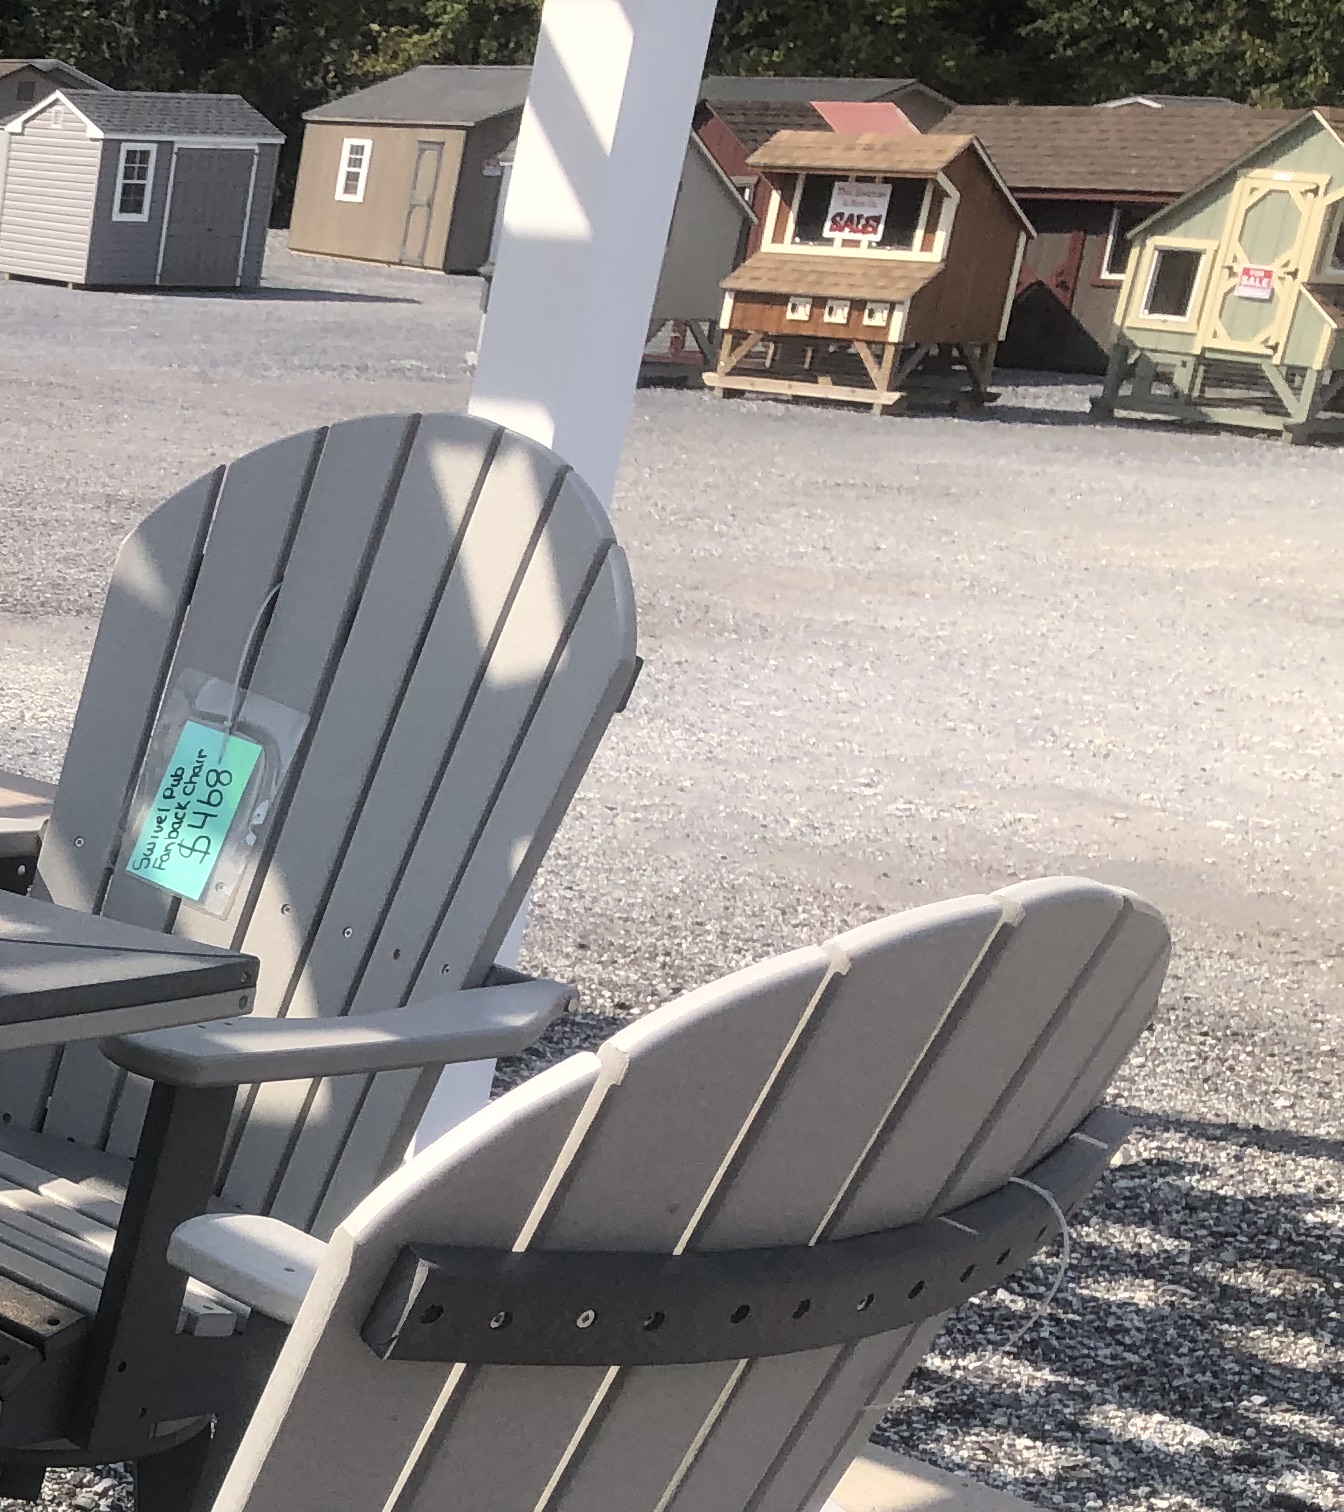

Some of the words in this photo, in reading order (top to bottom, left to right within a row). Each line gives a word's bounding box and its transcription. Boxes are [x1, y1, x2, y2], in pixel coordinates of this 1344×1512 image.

[1241, 275, 1271, 288] SALE
[132, 808, 171, 871] Swivel
[162, 766, 185, 800] Pub
[176, 768, 233, 865] $468
